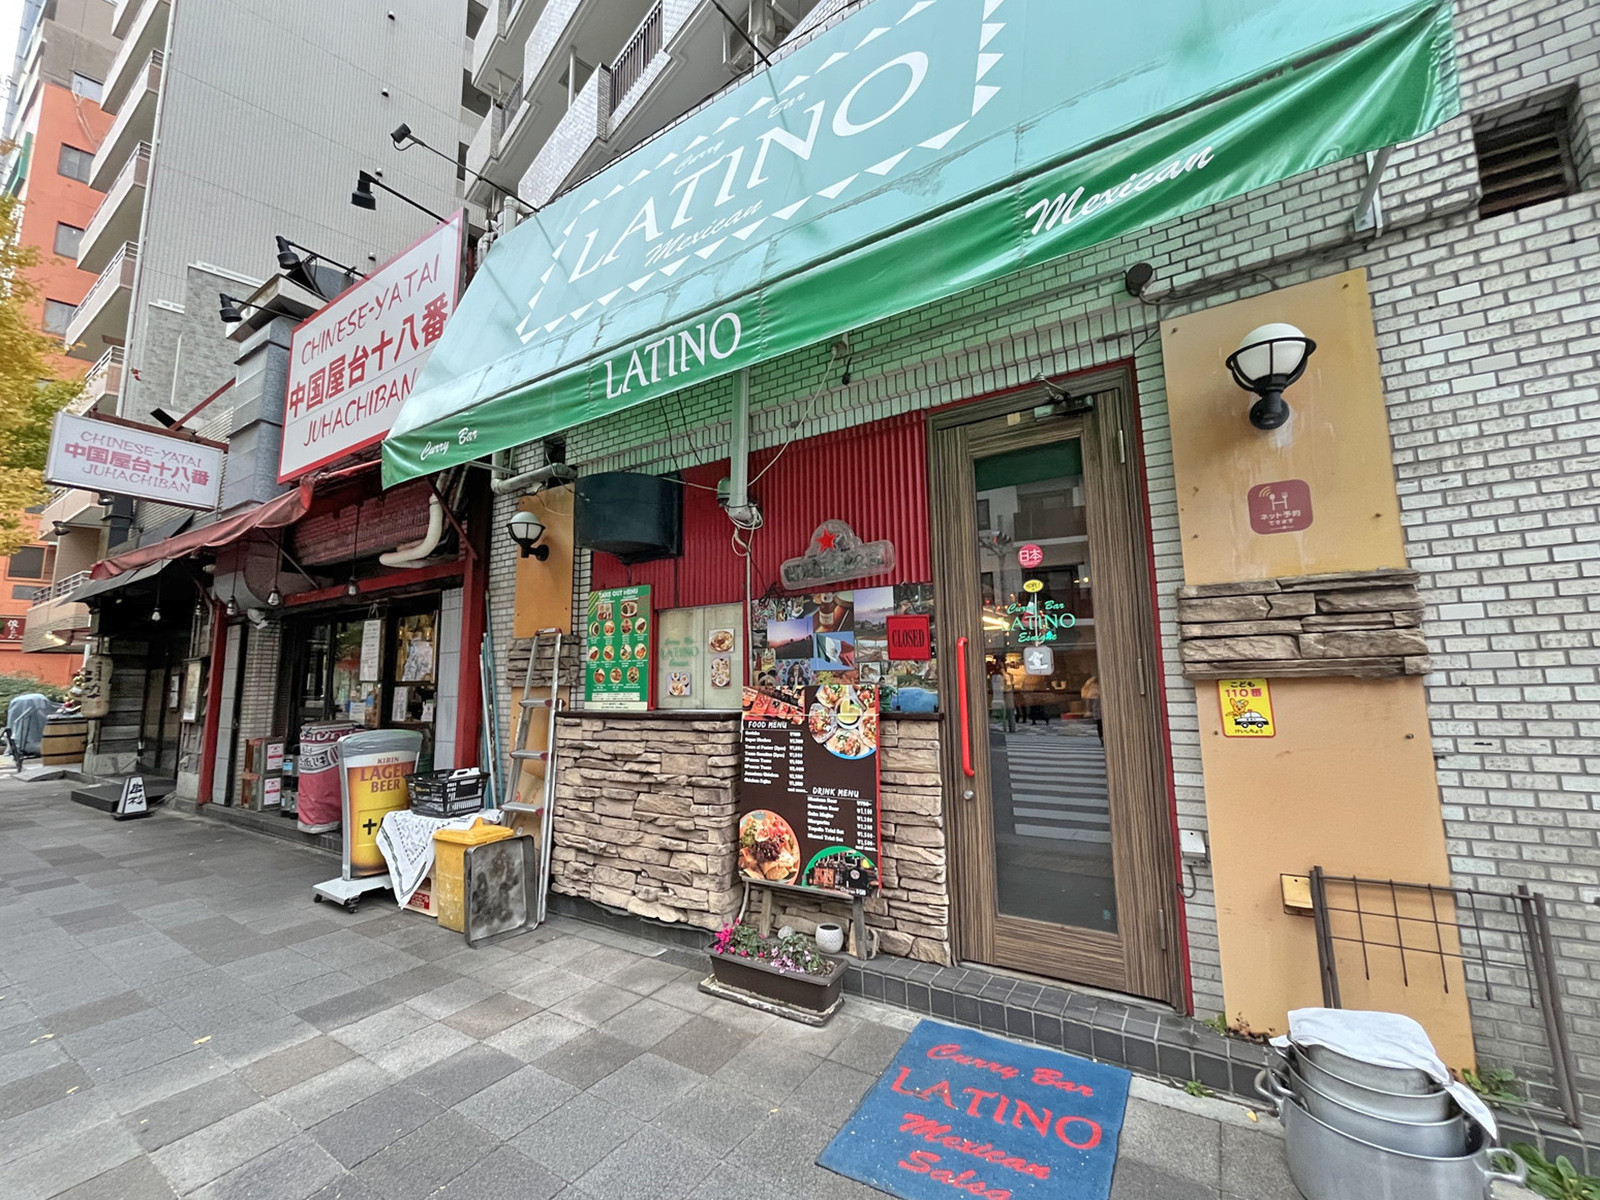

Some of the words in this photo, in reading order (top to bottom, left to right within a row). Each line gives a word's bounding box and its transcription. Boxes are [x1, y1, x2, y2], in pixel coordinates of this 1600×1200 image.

[767, 91, 806, 120] Bar
[568, 50, 930, 284] LATINO
[1025, 145, 1215, 236] Mexican
[644, 199, 764, 268] Mexican
[300, 253, 440, 366] CHINESE-YATAI
[288, 291, 449, 419] 中国屋台十八番
[603, 311, 742, 400] LATINO
[303, 367, 418, 447] JUHACHIBAN
[64, 441, 210, 487] 中国屋台十八番
[80, 430, 202, 468] CHINESE-YATAI
[420, 439, 450, 461] Curry
[457, 427, 478, 446] Bar
[82, 463, 191, 494] JUHACHIBAN
[1019, 548, 1042, 562] 日本
[1044, 600, 1065, 610] Bar
[892, 629, 925, 648] CLOSED
[748, 721, 767, 729] FOOD
[768, 721, 788, 729] MENU
[376, 756, 400, 765] KIRIN
[371, 779, 401, 794] BEER
[812, 786, 836, 796] DRINK
[837, 788, 860, 798] MENU
[926, 1043, 1019, 1080] Curry
[1033, 1067, 1094, 1097] Bar
[890, 1065, 1103, 1150] LATINO
[899, 1112, 1050, 1180] Mexican
[897, 1149, 1012, 1200] Salsa
